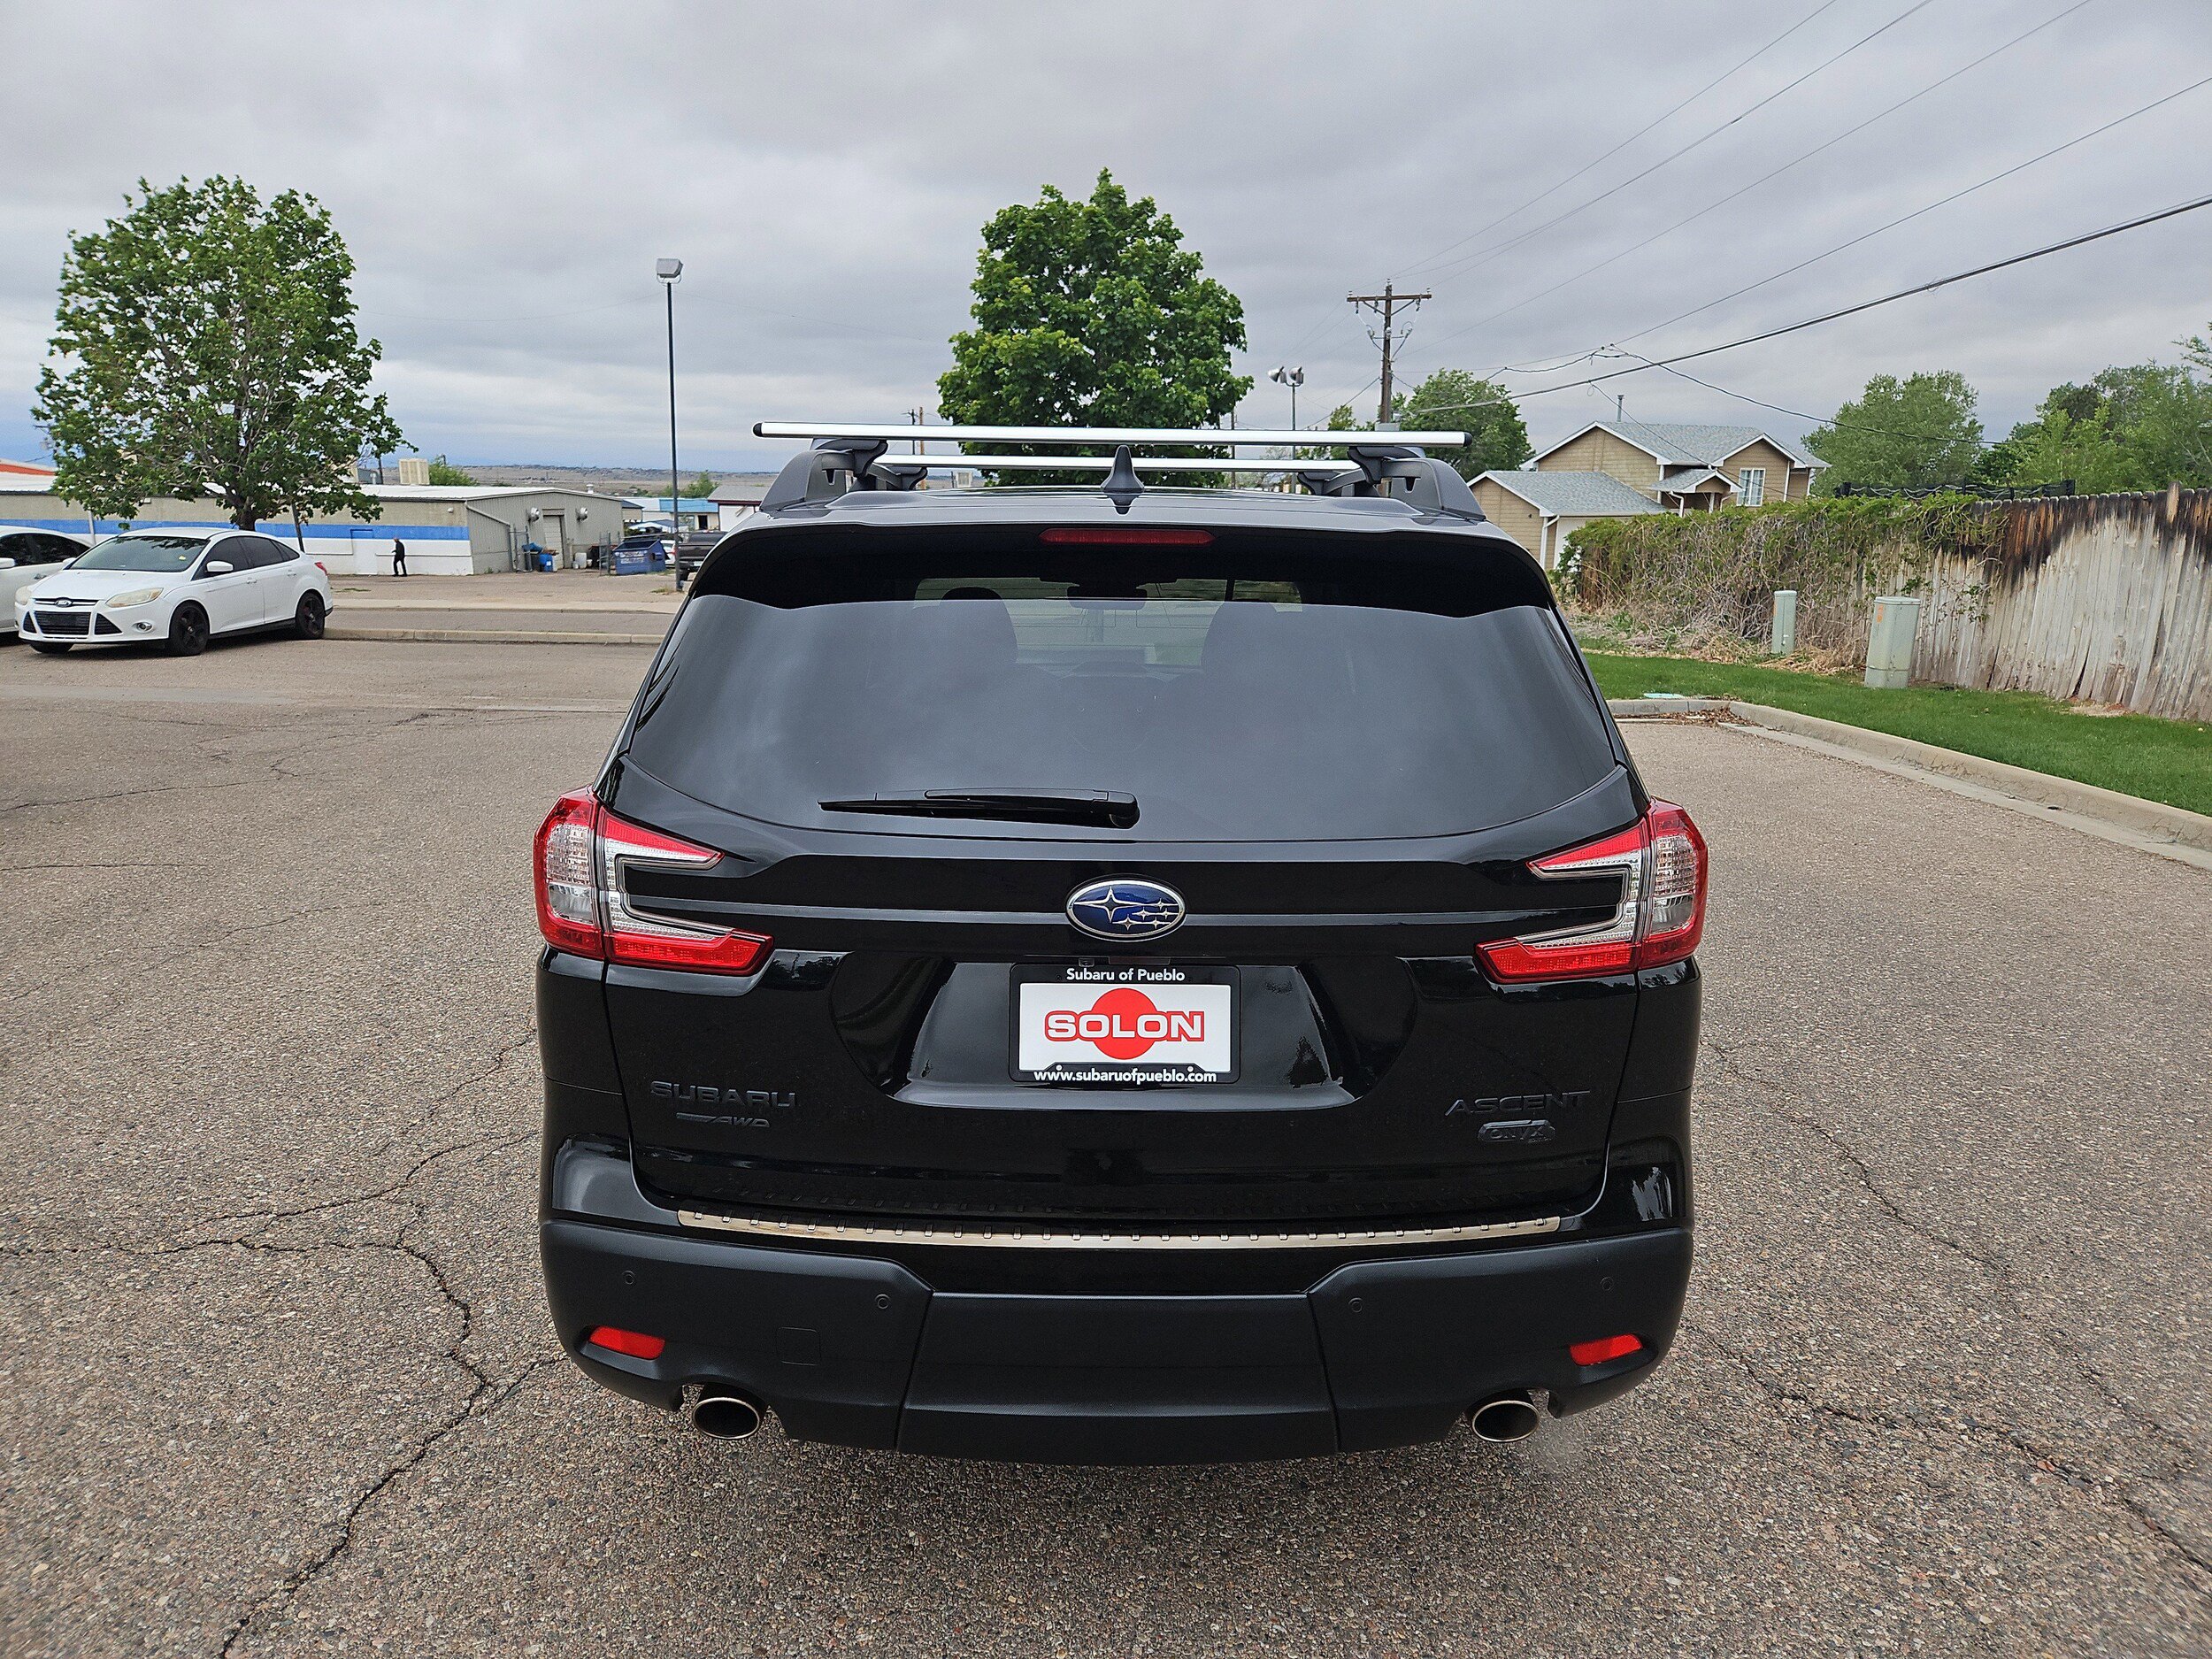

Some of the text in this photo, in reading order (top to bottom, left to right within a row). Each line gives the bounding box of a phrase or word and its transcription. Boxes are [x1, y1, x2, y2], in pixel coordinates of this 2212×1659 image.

[1066, 968, 1185, 981] Subaru of Pueblo
[1046, 1011, 1204, 1041] SOLON
[1033, 1069, 1217, 1085] www.subaruofpueblo.com
[650, 1080, 795, 1107] SUBARU
[1445, 1090, 1590, 1116] ASCENT
[709, 1116, 770, 1128] AWD
